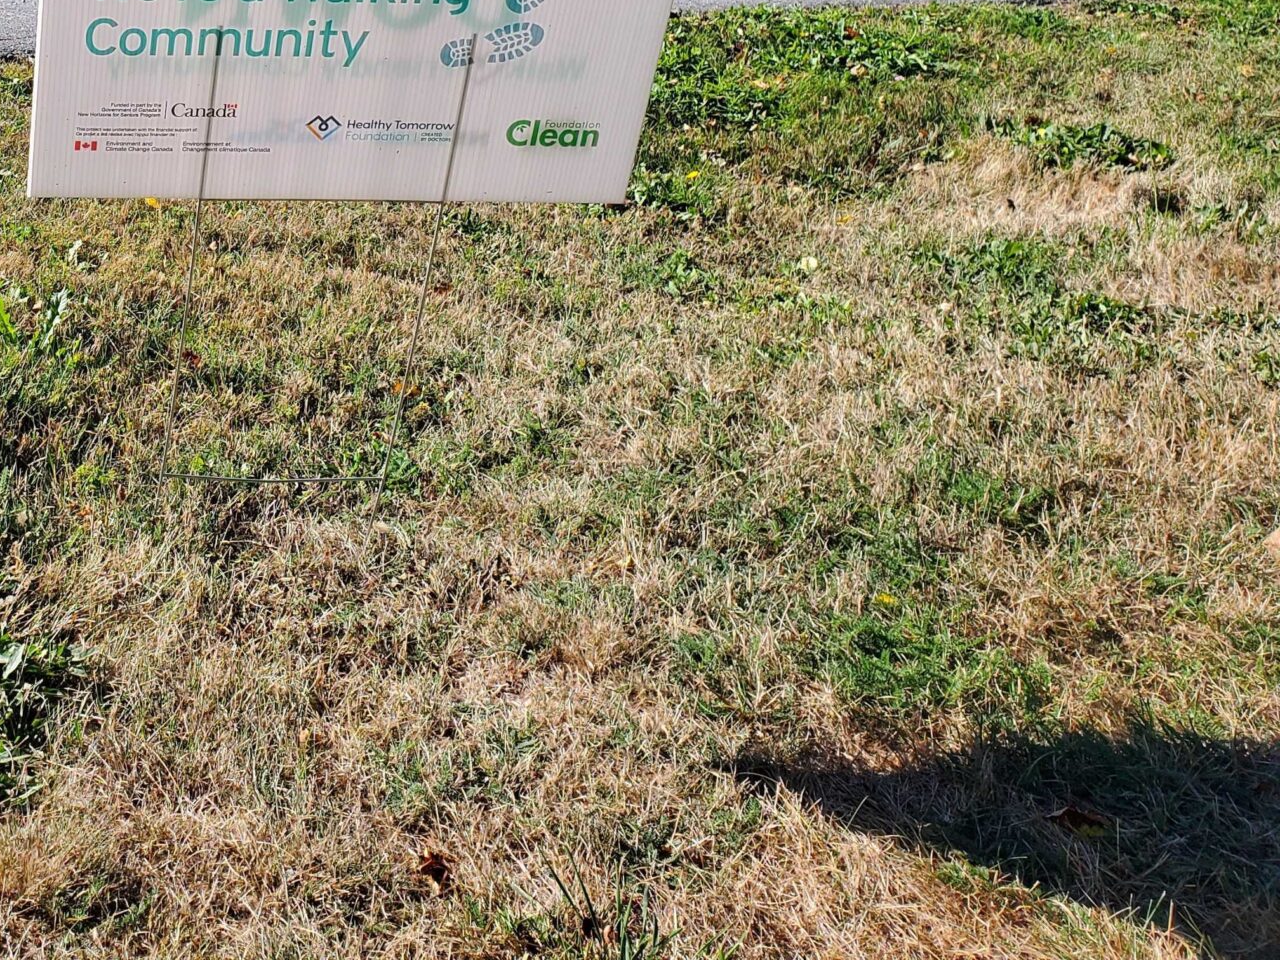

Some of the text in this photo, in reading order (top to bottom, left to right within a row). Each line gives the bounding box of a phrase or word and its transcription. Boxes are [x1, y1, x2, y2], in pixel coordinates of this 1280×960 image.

[85, 17, 371, 68] Community
[171, 102, 238, 118] Canada
[346, 119, 455, 131] Healthy Tomorrow
[544, 119, 601, 129] Foundation
[345, 131, 410, 142] Foundation
[506, 119, 600, 148] Clean
